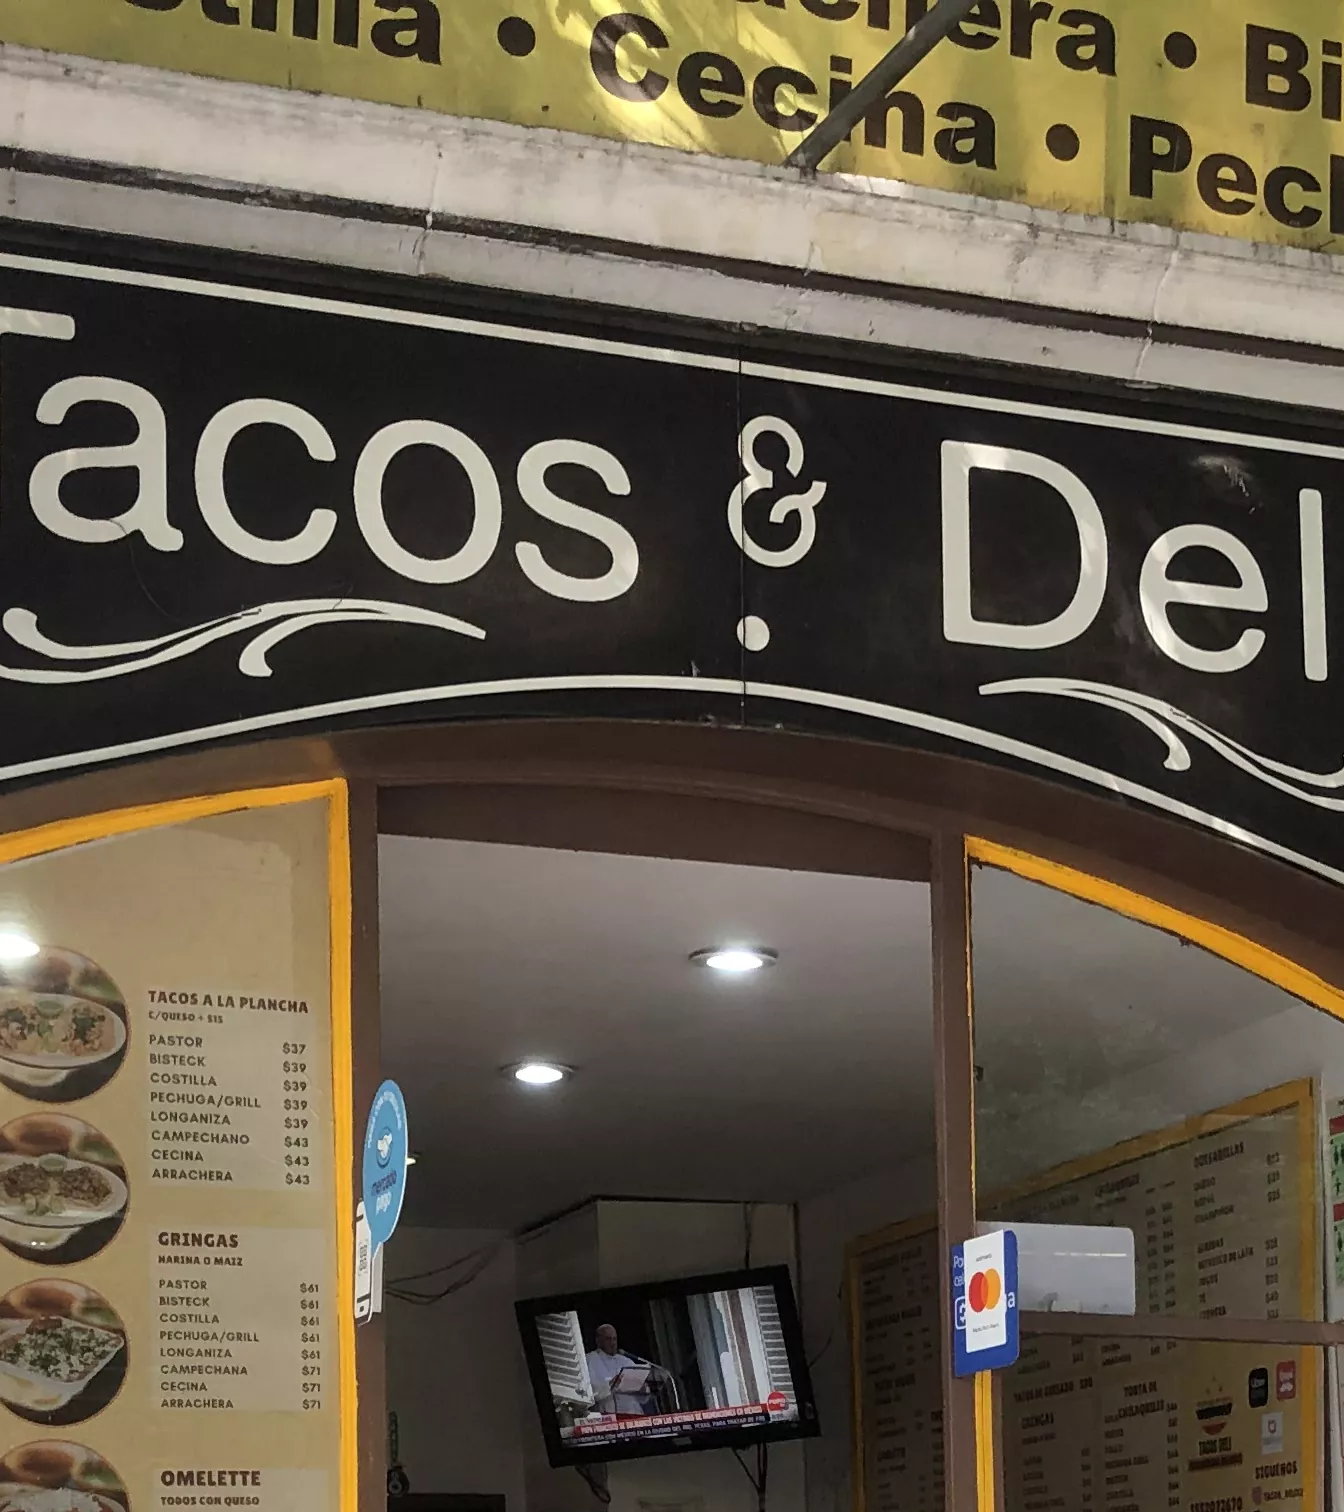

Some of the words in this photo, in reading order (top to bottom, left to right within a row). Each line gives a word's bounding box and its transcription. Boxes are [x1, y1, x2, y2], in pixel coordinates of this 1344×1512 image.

[589, 12, 997, 171] Cecina
[726, 413, 827, 570] &
[147, 990, 199, 1005] TACOS
[202, 994, 213, 1007] A
[217, 995, 235, 1009] LA
[239, 996, 309, 1014] PLANCHA
[149, 1034, 203, 1048] PASTOR
[282, 1041, 307, 1055] $37
[149, 1053, 205, 1067] BISTECK
[282, 1060, 307, 1074] $39
[151, 1130, 250, 1145] CAMPECHANO
[284, 1135, 309, 1149] $43
[158, 1231, 239, 1249] GRINGAS
[213, 1256, 243, 1267] MAIZ
[158, 1279, 207, 1290] PASTOR
[299, 1282, 319, 1294] $61
[160, 1470, 261, 1487] OMELETTE
[223, 1496, 260, 1507] QUESO
